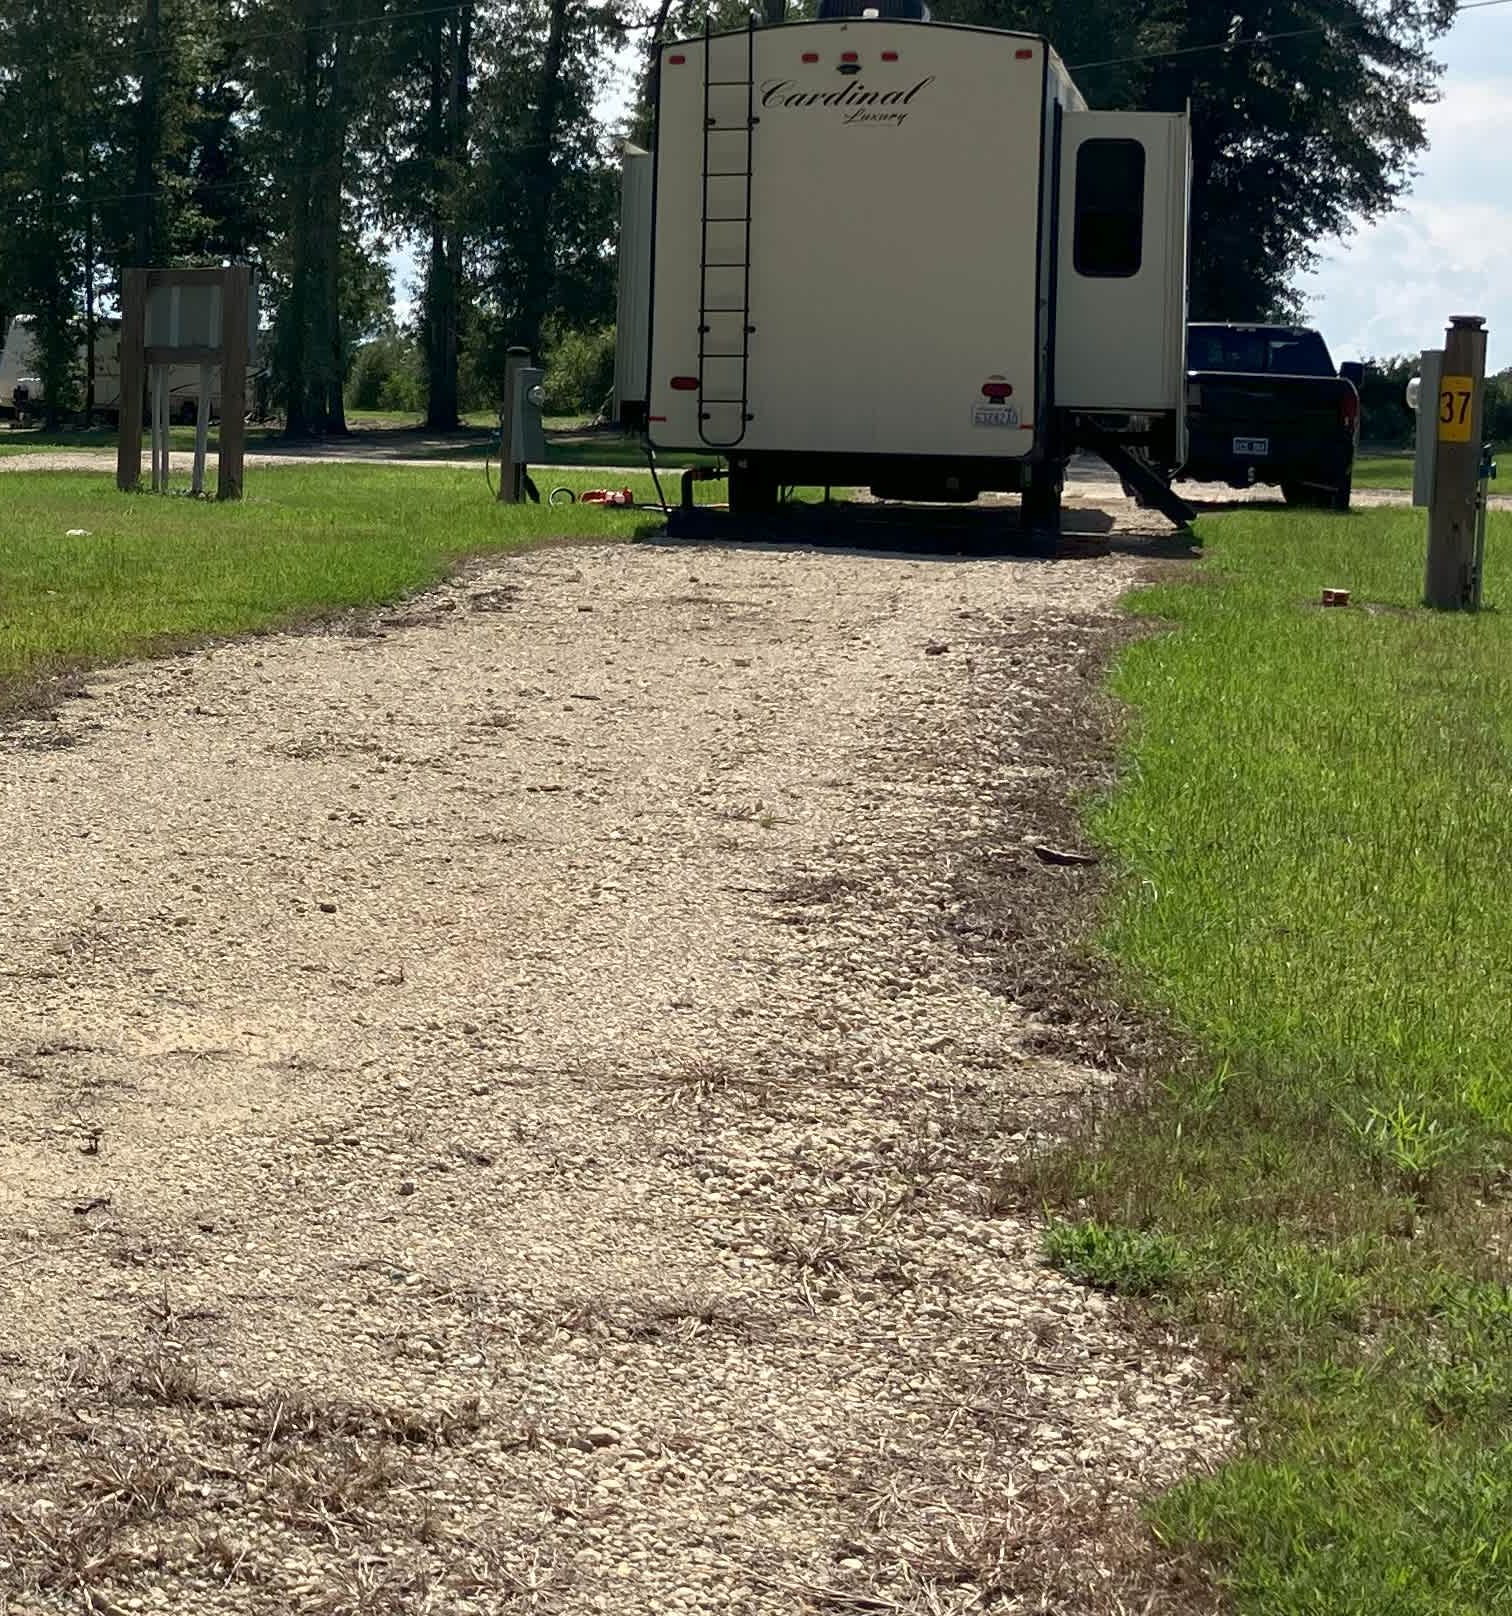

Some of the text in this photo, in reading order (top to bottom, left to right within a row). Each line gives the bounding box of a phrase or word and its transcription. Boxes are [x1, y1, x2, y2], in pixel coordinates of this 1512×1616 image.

[760, 75, 935, 108] Cardinal
[843, 108, 908, 127] Luxury
[1439, 391, 1471, 424] 37
